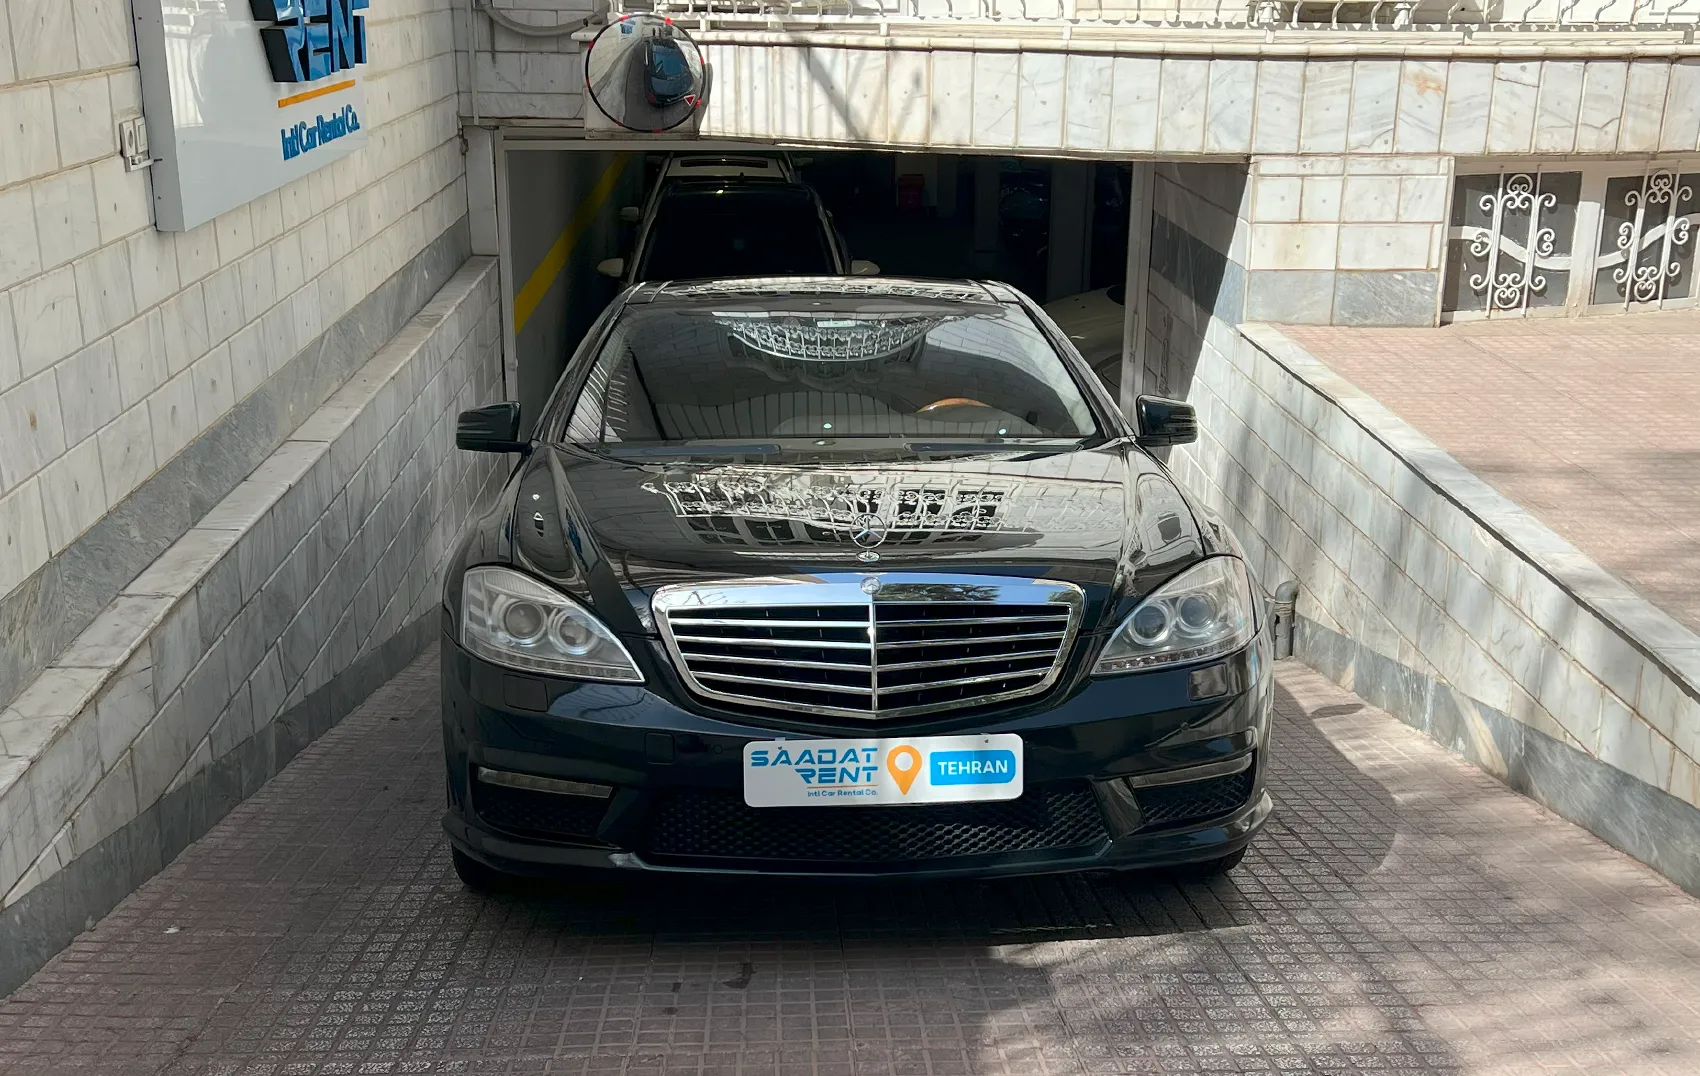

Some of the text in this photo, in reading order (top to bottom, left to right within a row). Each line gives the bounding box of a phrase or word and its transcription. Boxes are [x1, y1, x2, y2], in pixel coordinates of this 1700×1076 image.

[258, 0, 369, 82] RENT
[298, 120, 318, 153] Car
[316, 106, 347, 147] Rental
[345, 103, 361, 133] Co.
[750, 747, 878, 767] SAADAT
[794, 766, 878, 784] RENT
[937, 759, 1008, 775] TEHRAN
[821, 789, 836, 797] Car
[837, 787, 864, 797] Rental
